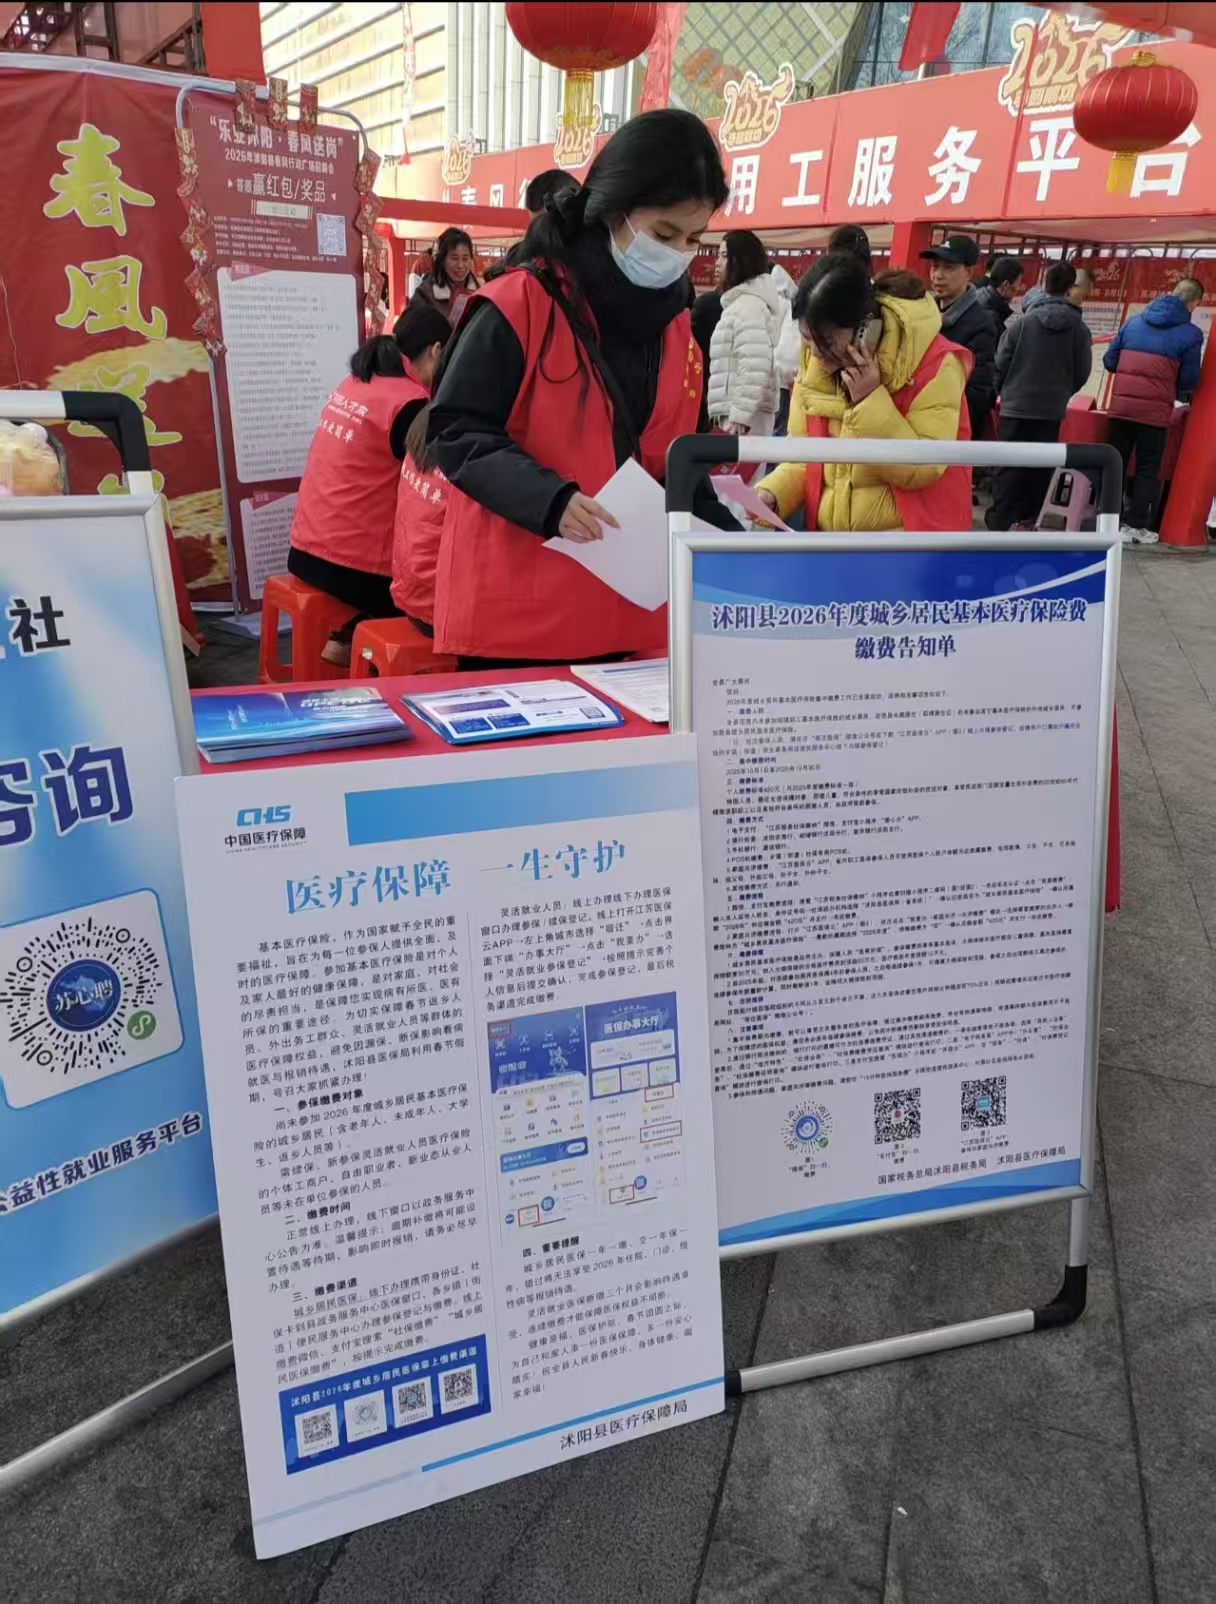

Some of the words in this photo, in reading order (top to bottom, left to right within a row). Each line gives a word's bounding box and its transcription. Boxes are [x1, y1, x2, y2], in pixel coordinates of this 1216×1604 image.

[724, 116, 1202, 217] 用工服务平台
[712, 598, 1087, 631] 沭阳县2026年度城乡居民基本医疗保险费
[854, 634, 957, 660] 缴费告知单
[224, 827, 307, 848] 中国医疗保障
[284, 857, 451, 915] 医疗保障
[480, 838, 626, 882] 一生守护
[559, 1397, 687, 1450] 沭阳县医疗保障局
